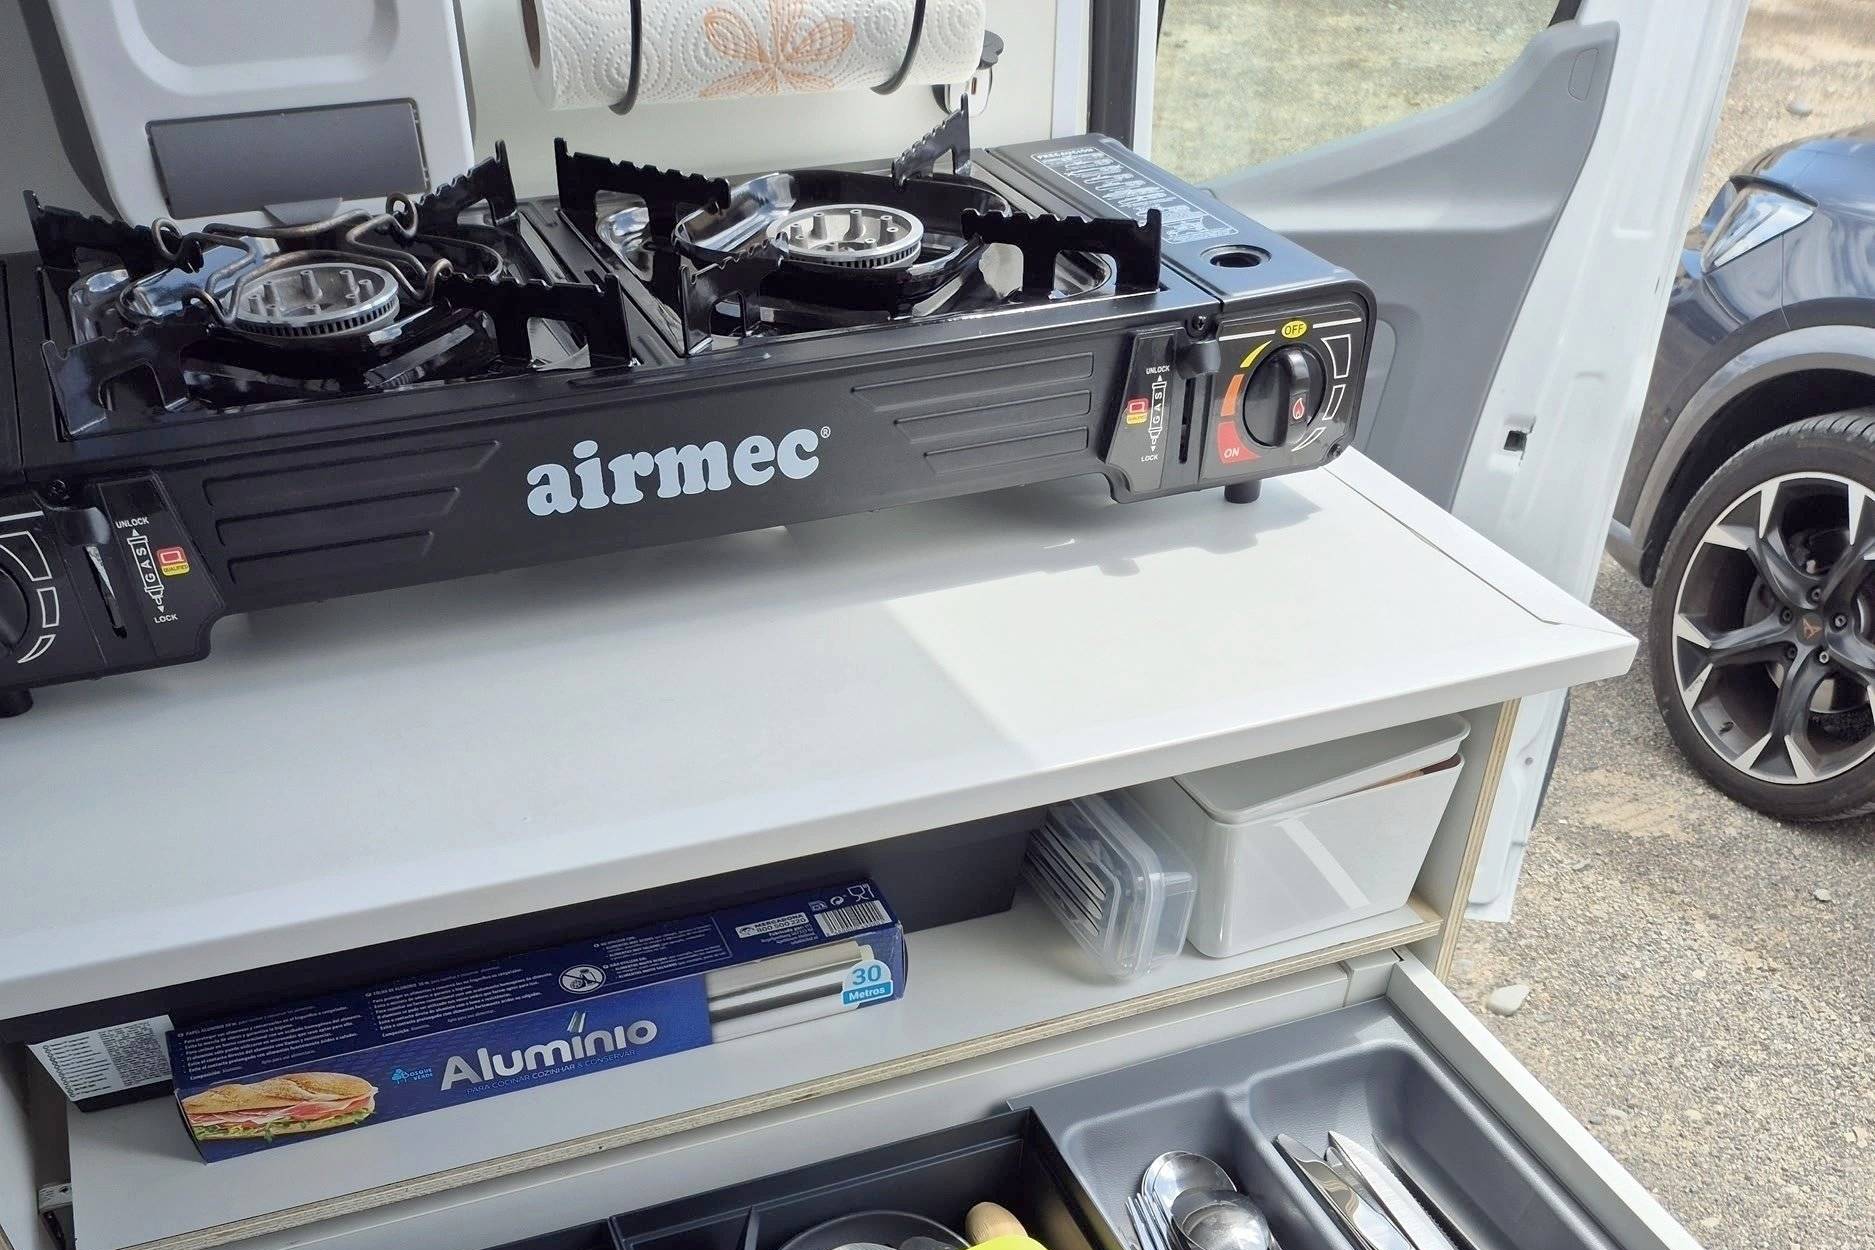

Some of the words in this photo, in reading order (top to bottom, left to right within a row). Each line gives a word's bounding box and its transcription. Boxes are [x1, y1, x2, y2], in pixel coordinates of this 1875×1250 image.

[1284, 323, 1305, 336] OFF
[1146, 365, 1170, 374] UNLOCK
[1154, 391, 1164, 424] GAS
[1141, 453, 1158, 462] LOCK
[1223, 446, 1240, 458] ON
[527, 428, 820, 517] airmec
[115, 516, 150, 529] UNLOCK
[136, 547, 156, 582] GAS
[153, 613, 178, 624] LOCK
[852, 964, 882, 986] 30
[849, 986, 886, 1001] Metros
